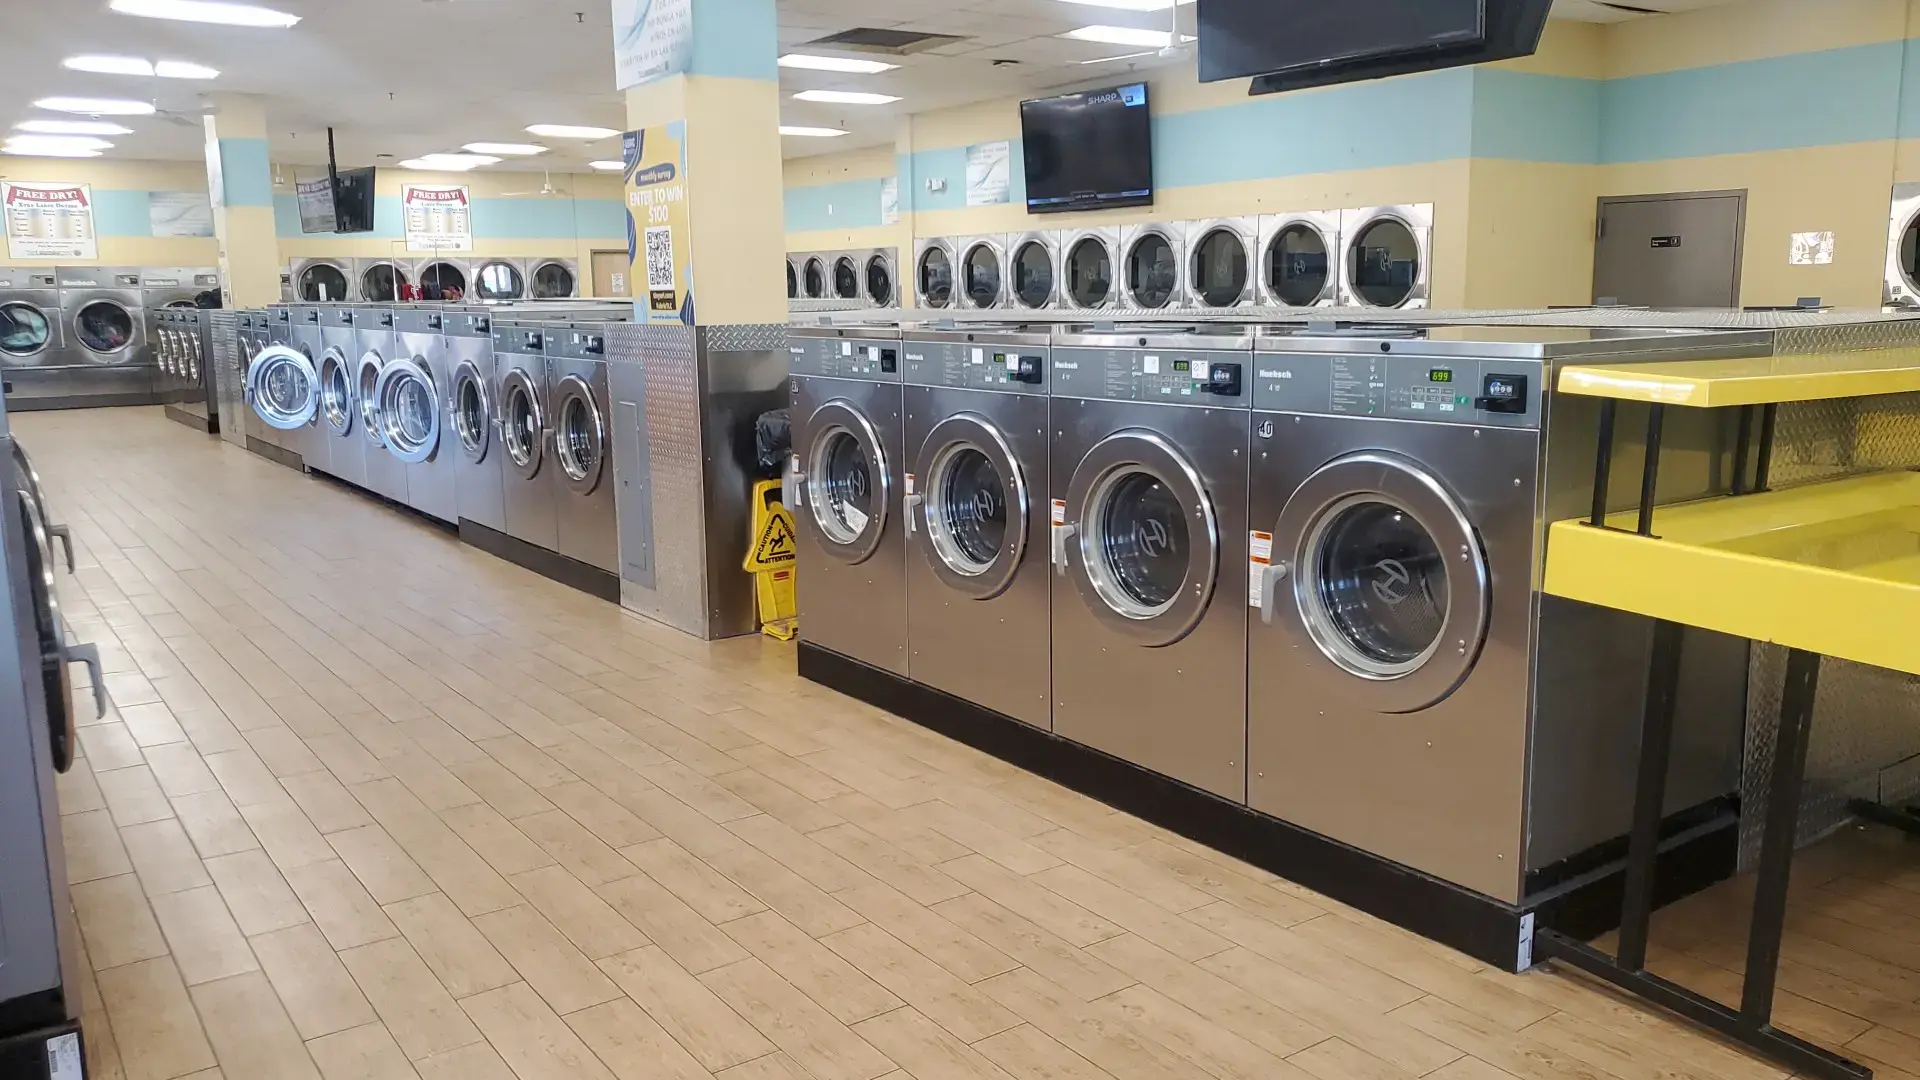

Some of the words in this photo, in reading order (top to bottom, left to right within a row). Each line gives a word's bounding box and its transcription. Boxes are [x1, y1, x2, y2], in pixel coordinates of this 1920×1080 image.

[1087, 93, 1117, 105] SHARP
[15, 188, 47, 200] FREE
[49, 190, 78, 200] DRY!
[413, 191, 437, 200] FREE
[437, 191, 459, 200] DRY!
[629, 190, 654, 207] ENTER
[654, 188, 665, 203] TO
[666, 185, 683, 202] WIN
[648, 204, 668, 224] $100
[1259, 369, 1293, 379] Huebsch
[1432, 371, 1449, 381] 699
[1258, 420, 1274, 439] 40
[758, 525, 773, 552] CAUTION
[765, 554, 796, 564] ATTENTION
